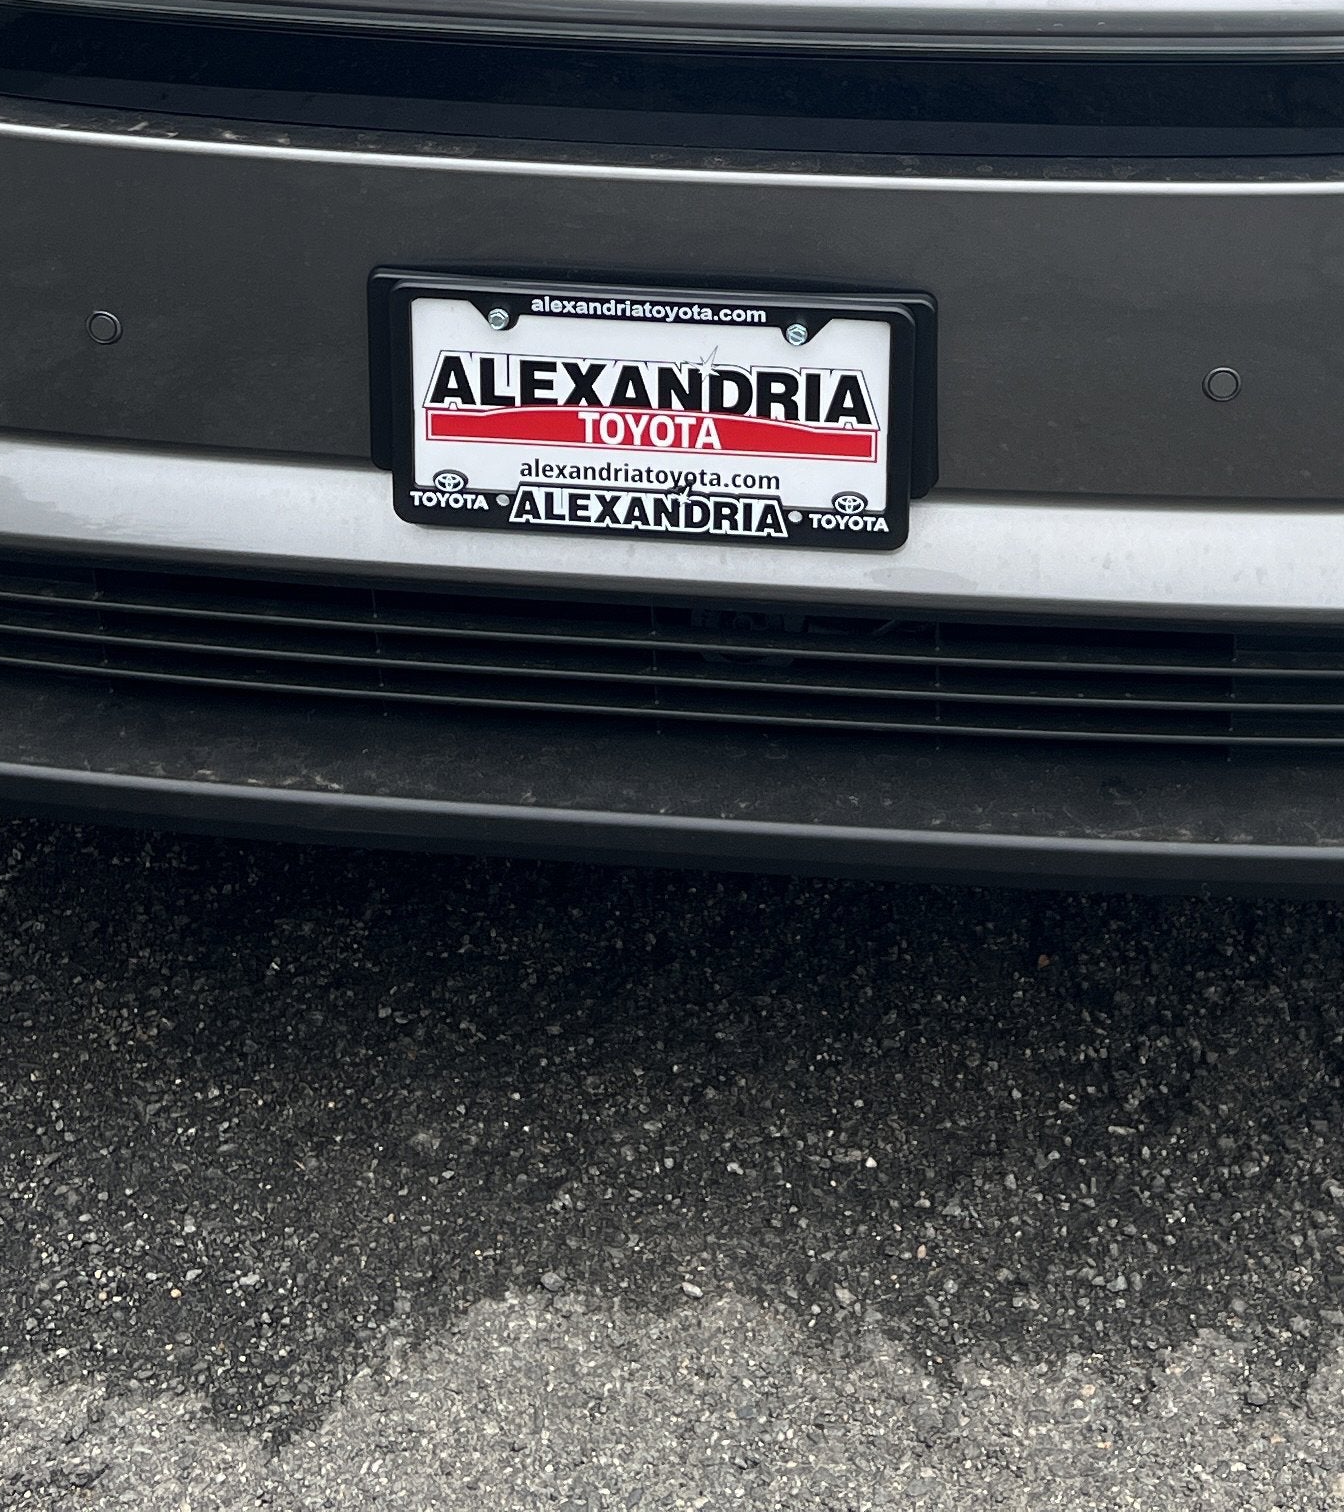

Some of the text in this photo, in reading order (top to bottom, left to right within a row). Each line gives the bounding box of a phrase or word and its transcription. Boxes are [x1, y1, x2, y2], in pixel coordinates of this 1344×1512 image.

[530, 295, 767, 324] alexandriatoyota.com
[428, 354, 873, 426] ALEXANDRIA
[577, 410, 722, 449] TOYOTA
[519, 458, 781, 491] alexandriatoyota.com
[409, 487, 890, 537] TOYOTA ALEXANDRIA TOYOTA
